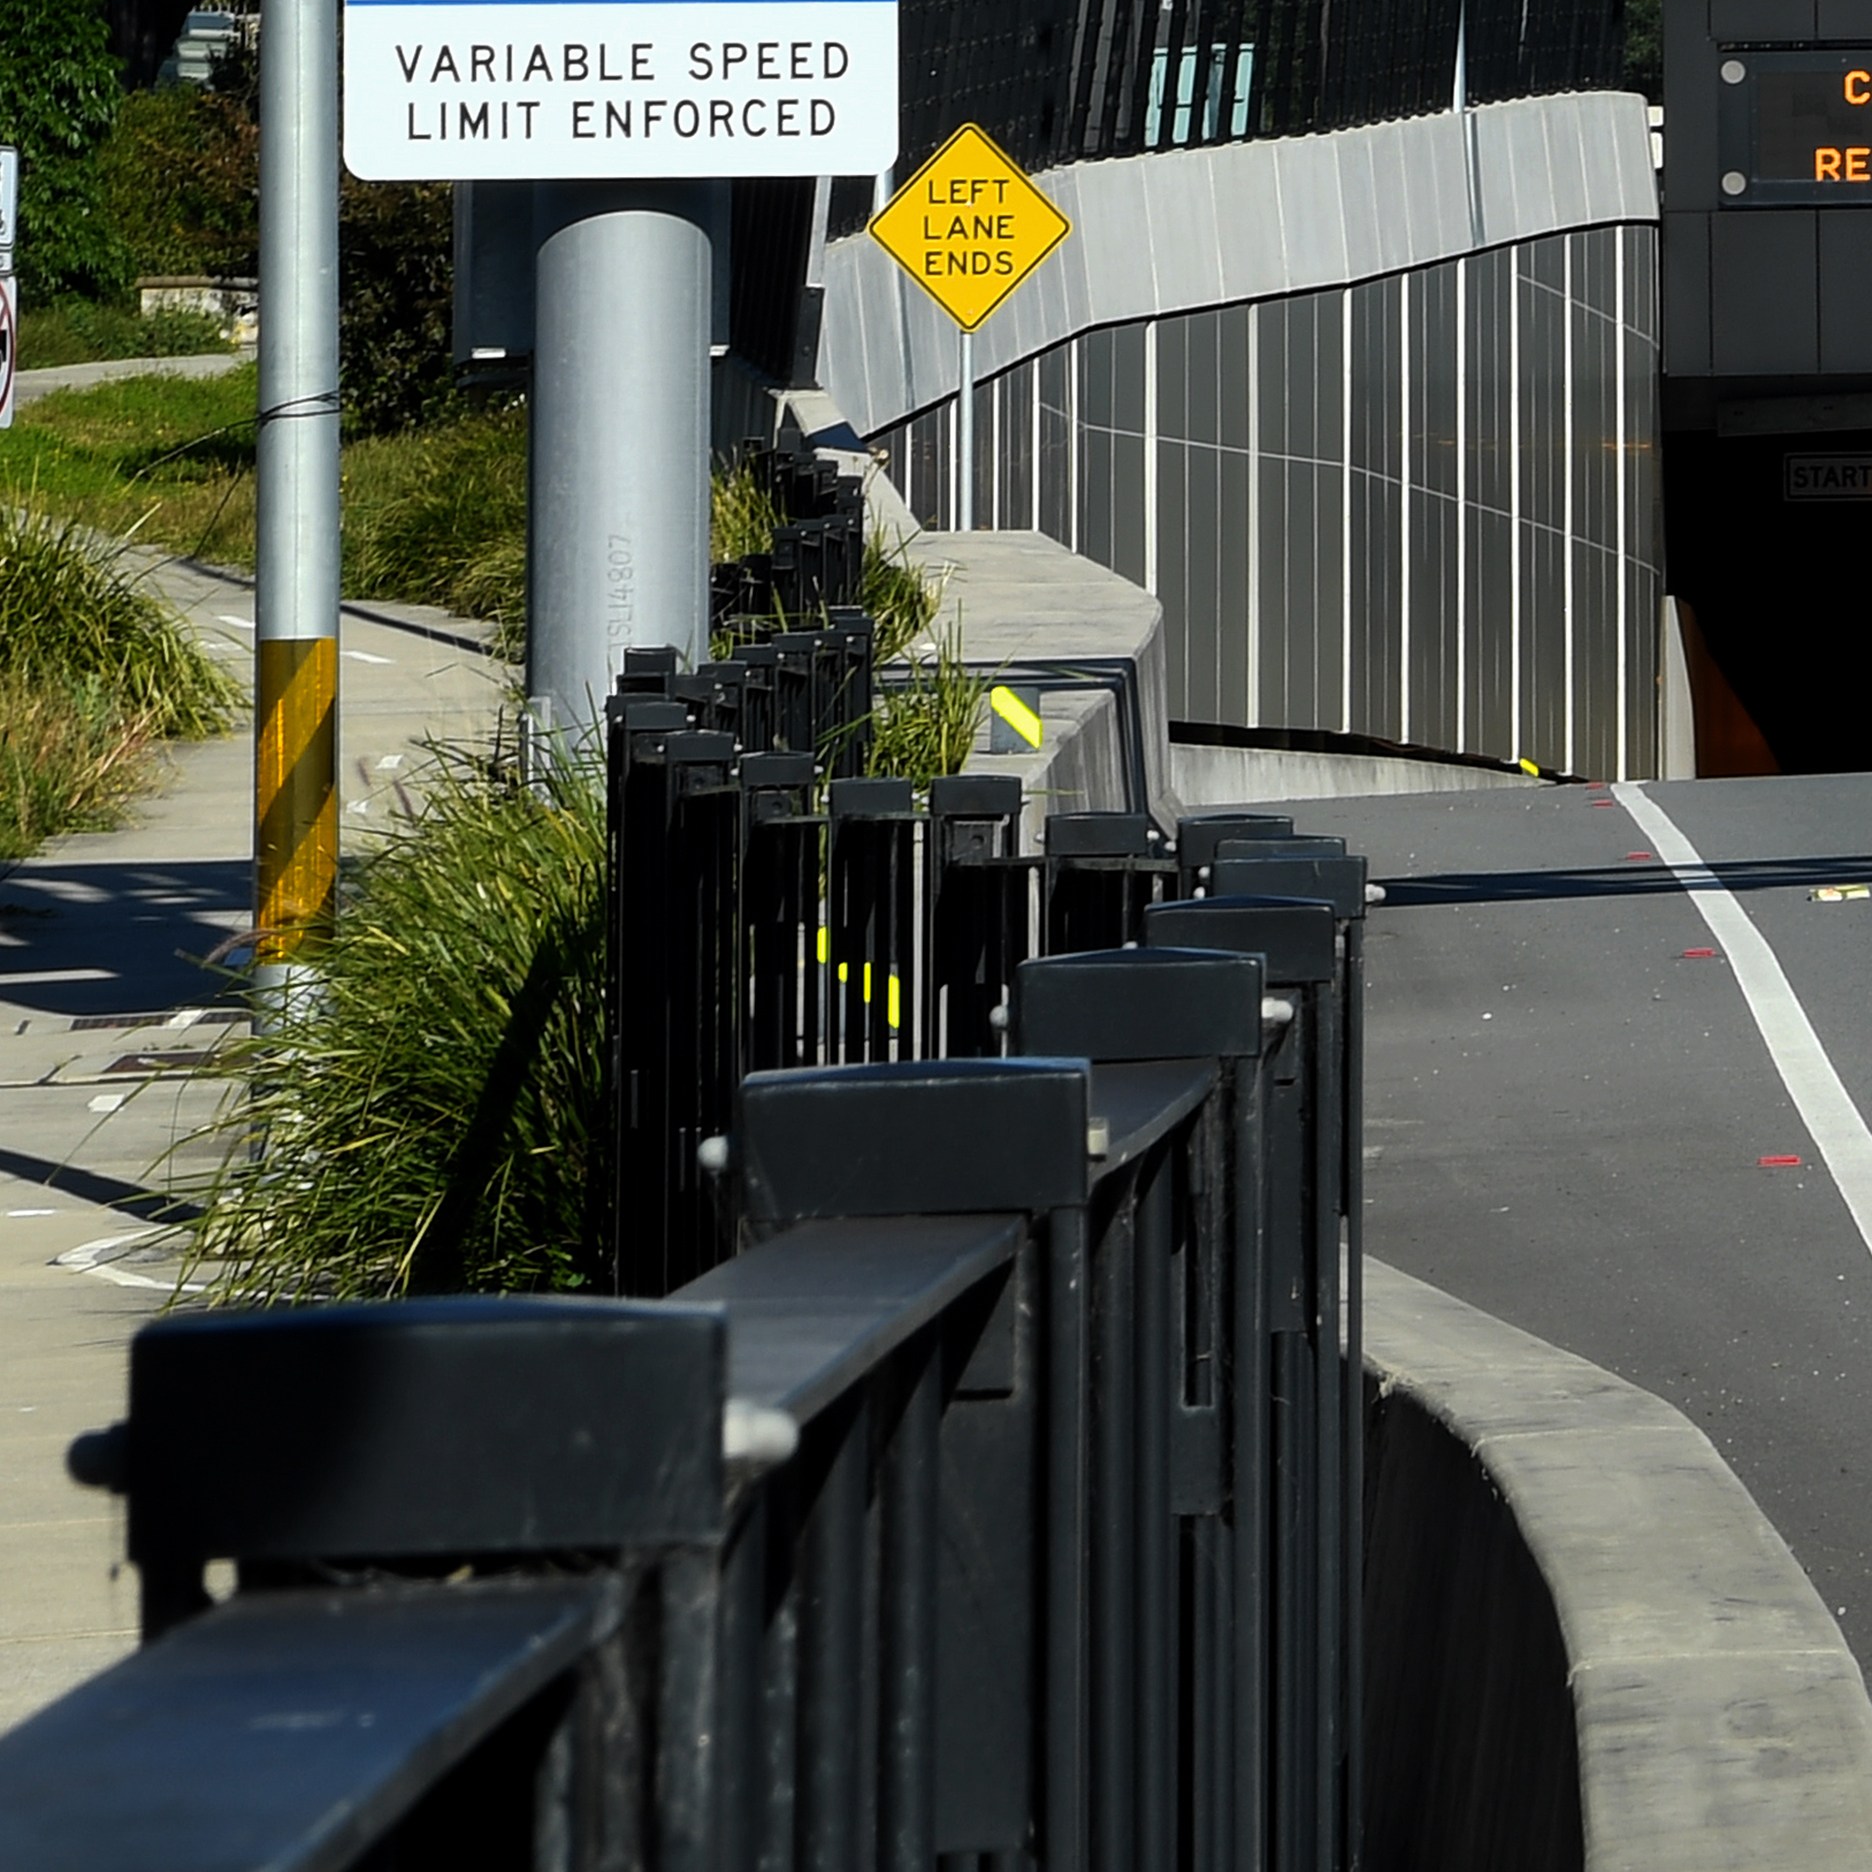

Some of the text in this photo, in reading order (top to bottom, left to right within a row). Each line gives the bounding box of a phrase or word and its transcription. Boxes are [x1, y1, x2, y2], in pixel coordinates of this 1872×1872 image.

[395, 42, 849, 83] VARIABLE SPEED
[408, 99, 835, 140] LIMIT ENFORCED
[929, 179, 1010, 204] LEFT
[924, 215, 1015, 240] LANE
[925, 251, 1013, 276] ENDS
[1793, 465, 1872, 488] START
